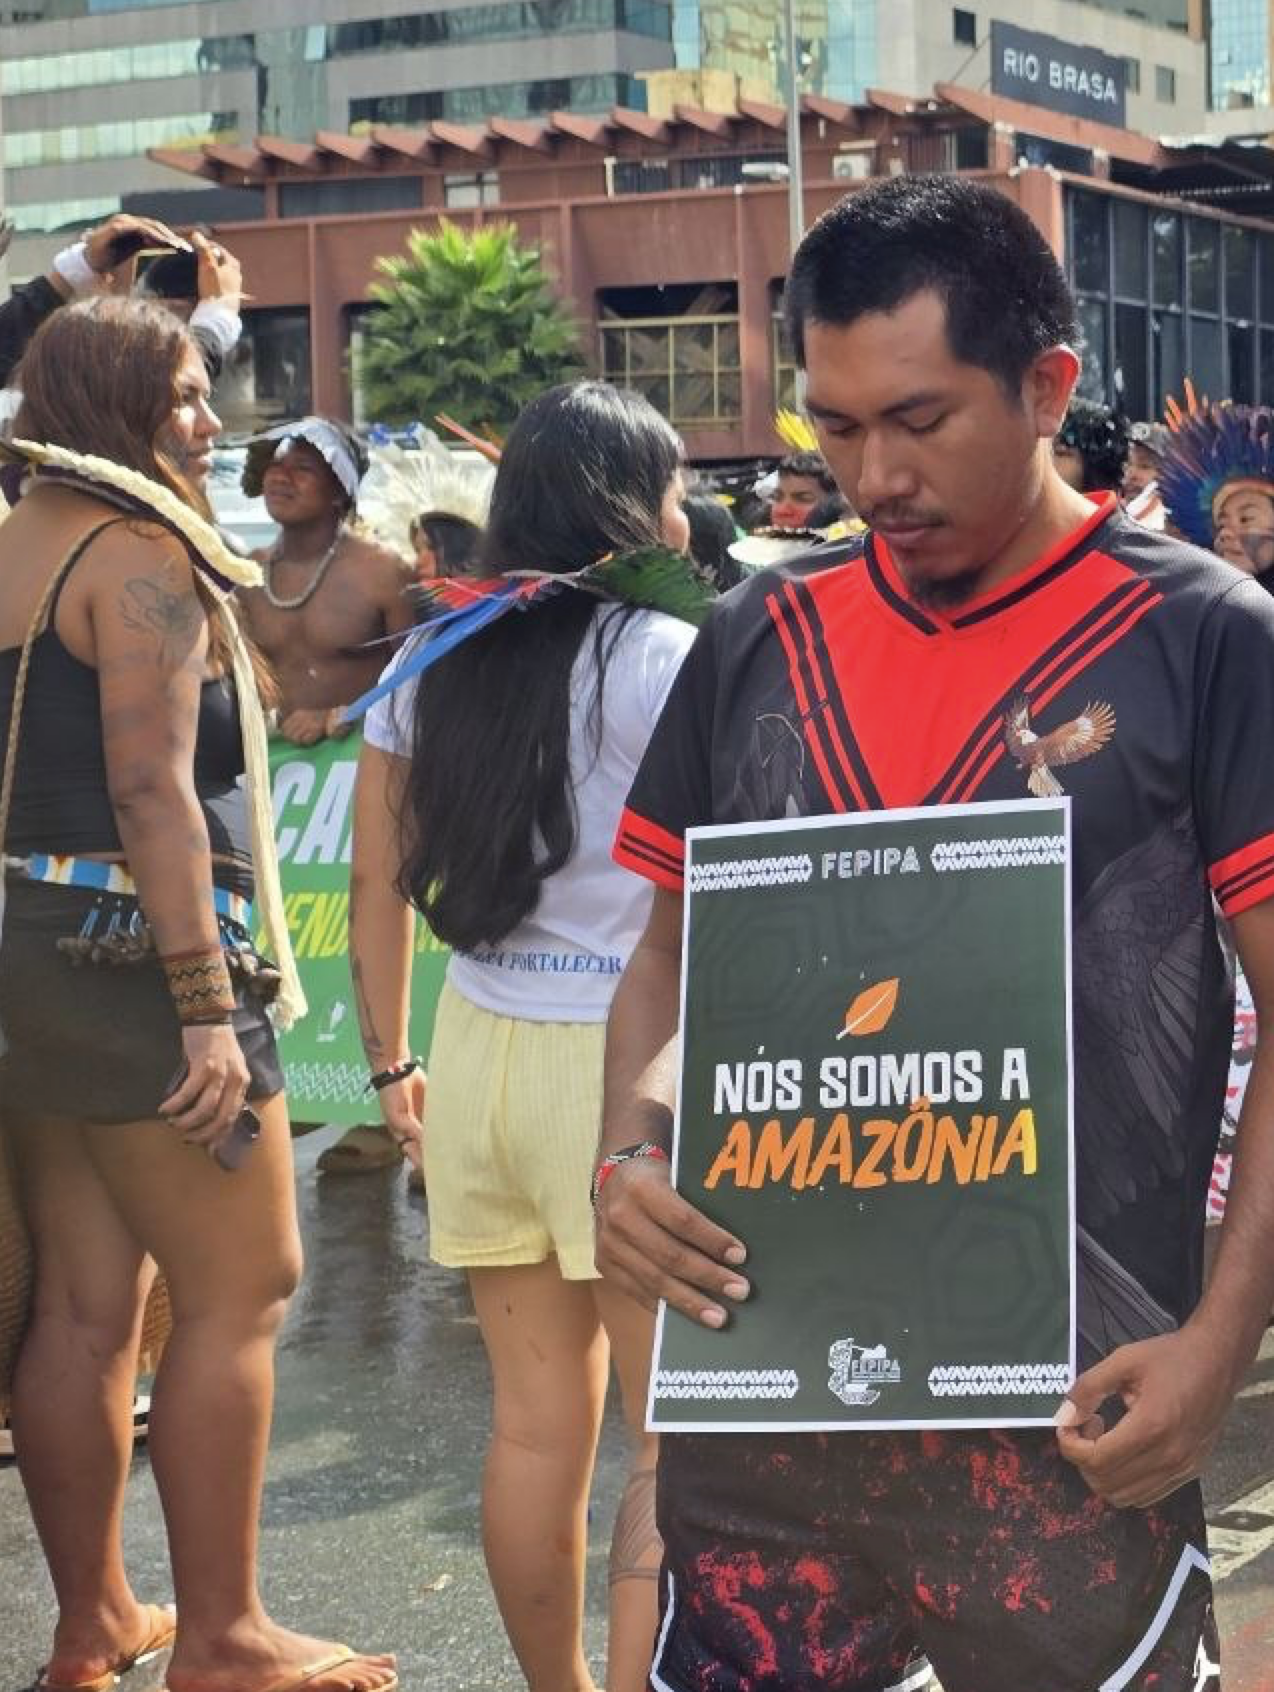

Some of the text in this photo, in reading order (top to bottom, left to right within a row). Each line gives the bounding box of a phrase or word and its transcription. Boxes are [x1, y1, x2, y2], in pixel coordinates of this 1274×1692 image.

[1002, 47, 1118, 105] RIO BRASA
[272, 761, 358, 865] CA
[820, 845, 921, 880] FEPIPA
[713, 1045, 1031, 1115] NÓS SOMOS A
[703, 1095, 1038, 1190] AMAZÔNIA
